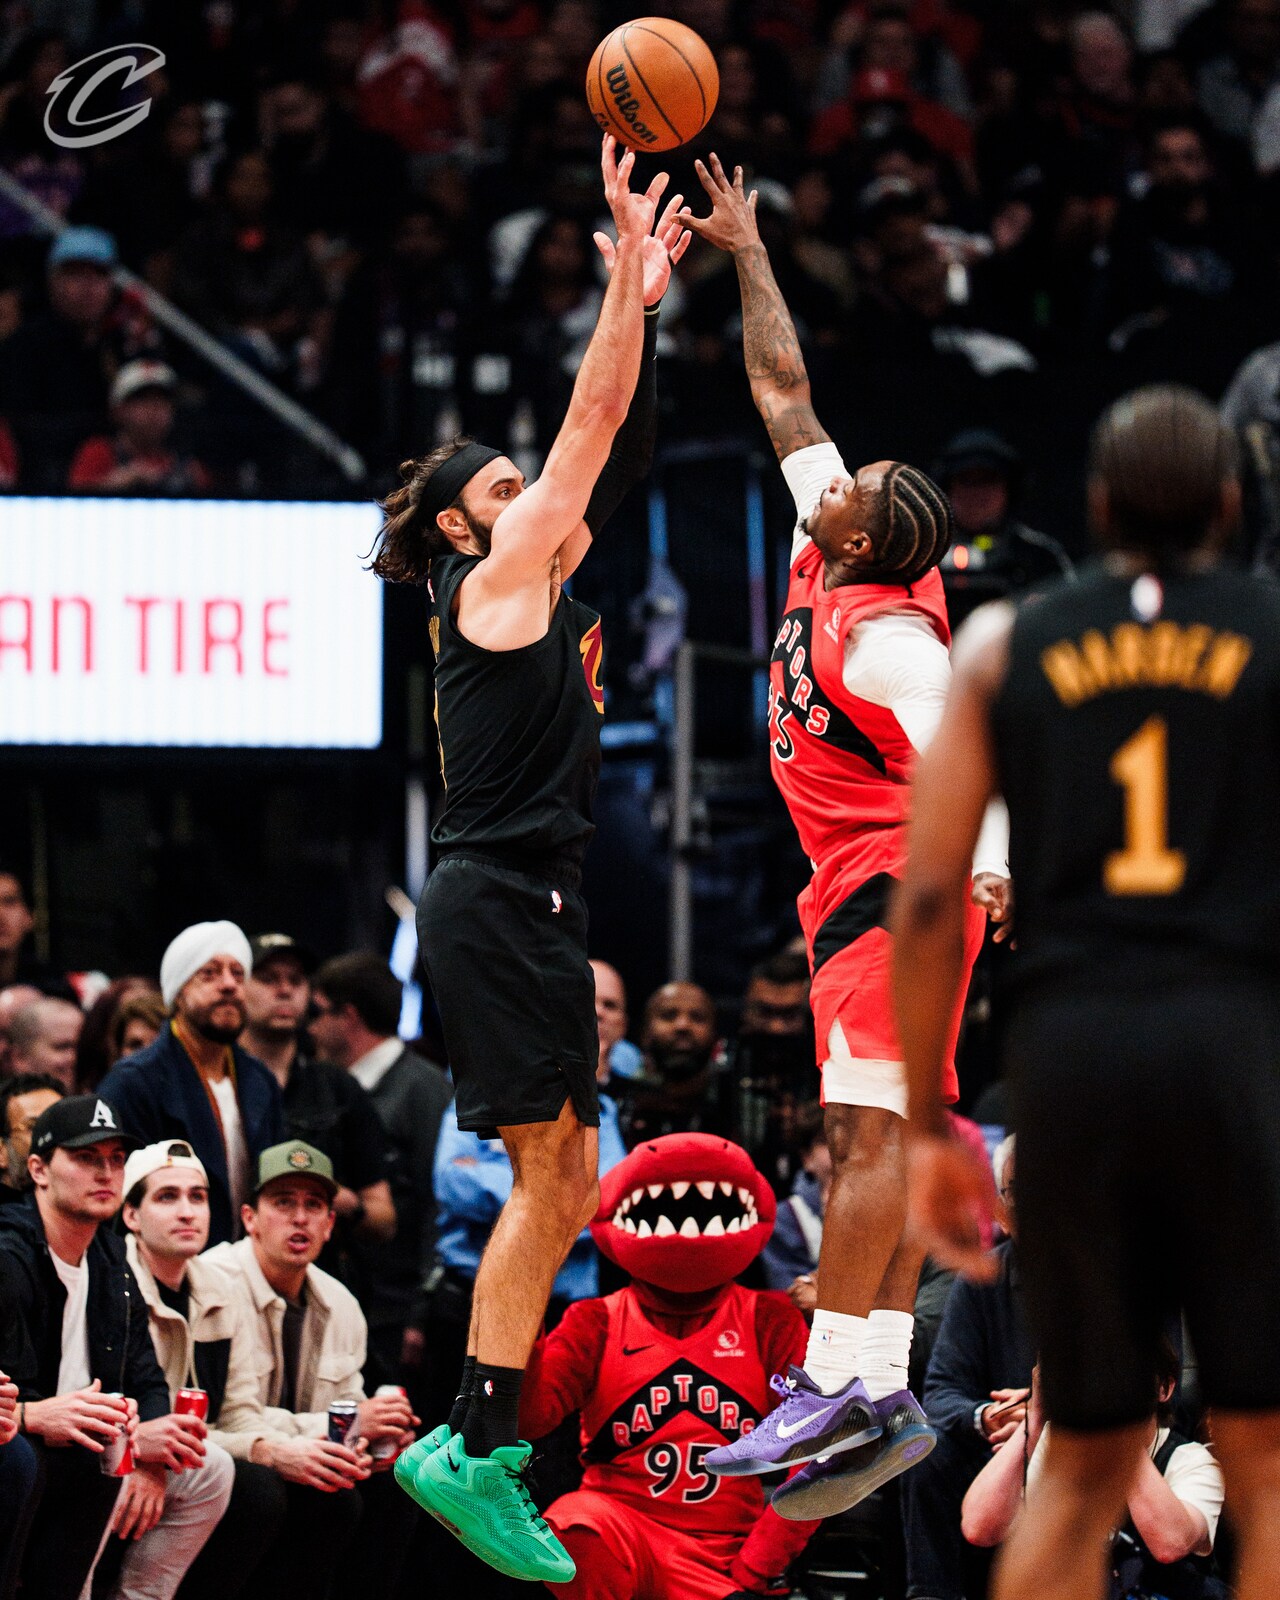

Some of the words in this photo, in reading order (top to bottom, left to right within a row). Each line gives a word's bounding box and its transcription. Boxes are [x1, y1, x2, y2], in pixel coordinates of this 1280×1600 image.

[606, 63, 658, 144] Wilson
[123, 595, 290, 677] TIRE
[774, 618, 830, 736] PTORS
[1103, 713, 1188, 897] 1
[88, 1098, 118, 1130] A
[643, 1442, 722, 1503] 95
